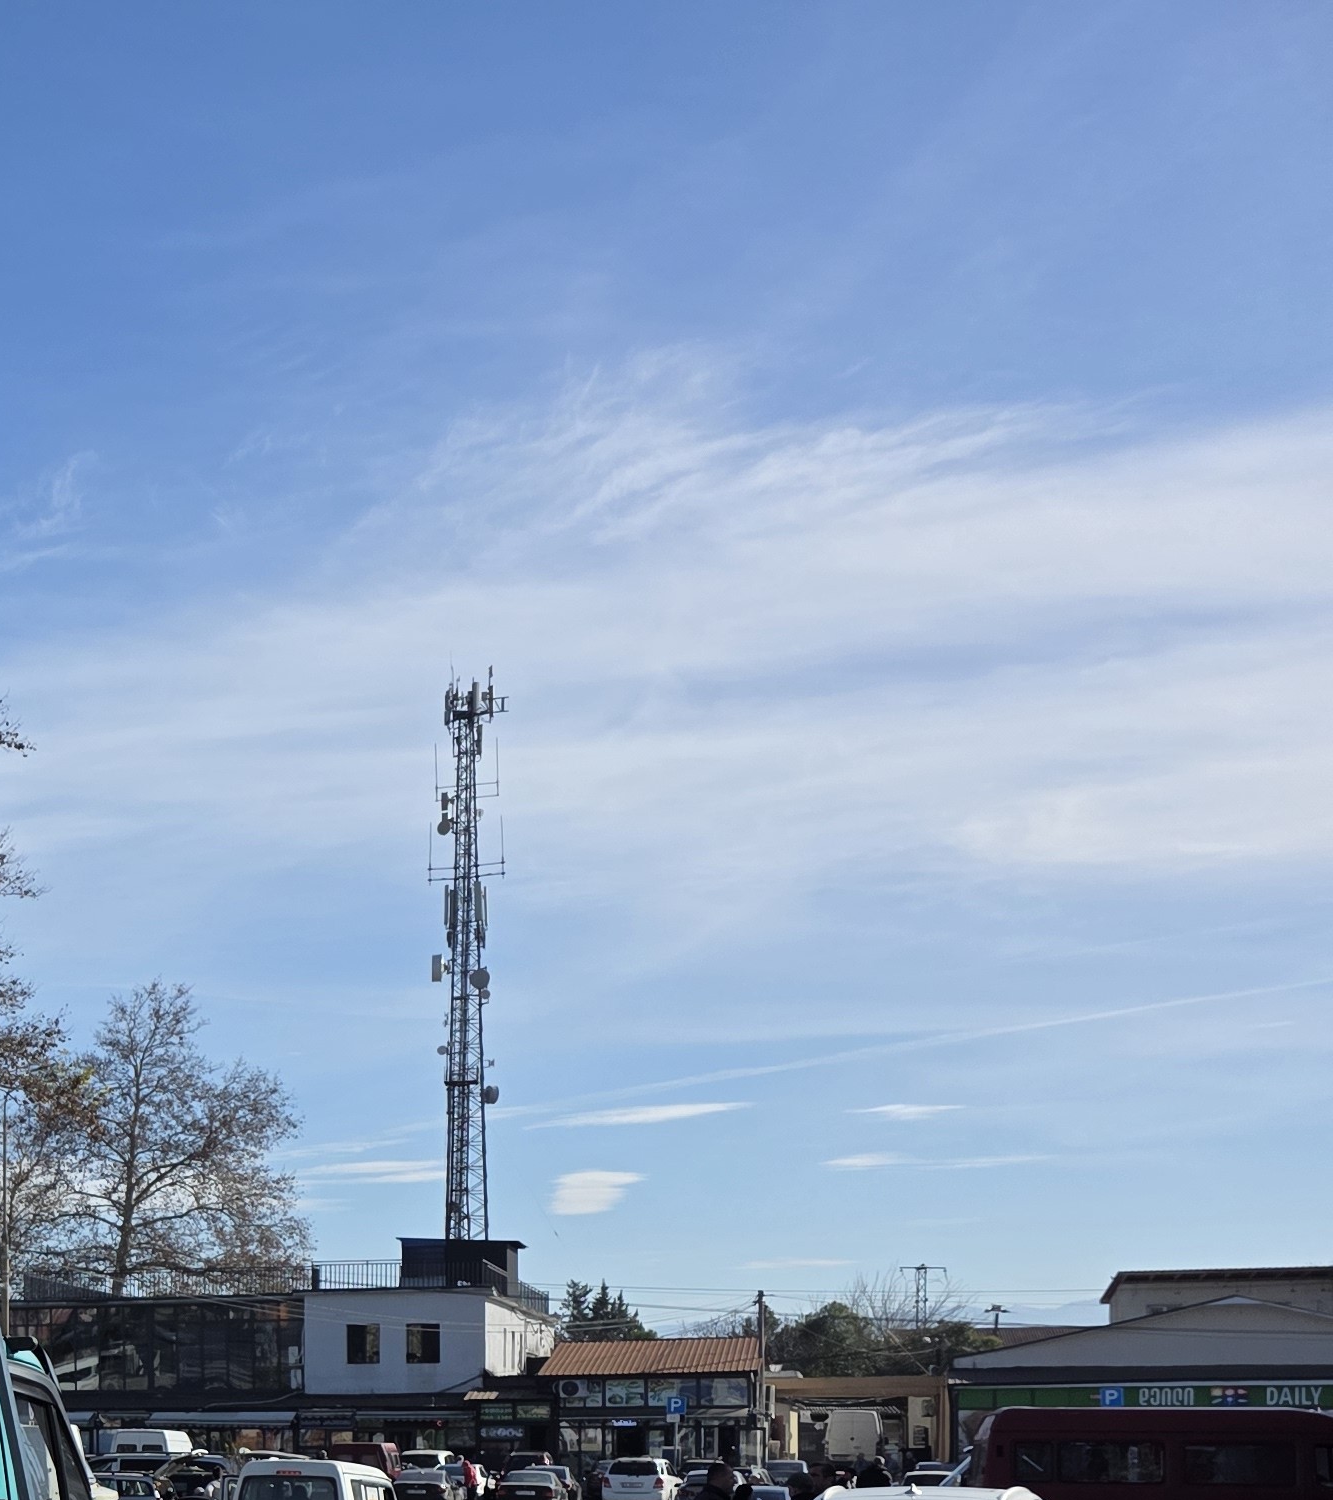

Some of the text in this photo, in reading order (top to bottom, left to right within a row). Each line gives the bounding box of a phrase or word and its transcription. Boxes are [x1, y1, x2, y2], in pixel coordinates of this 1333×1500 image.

[1105, 1389, 1118, 1405] P
[1266, 1387, 1322, 1406] DAILY
[671, 1398, 682, 1412] P
